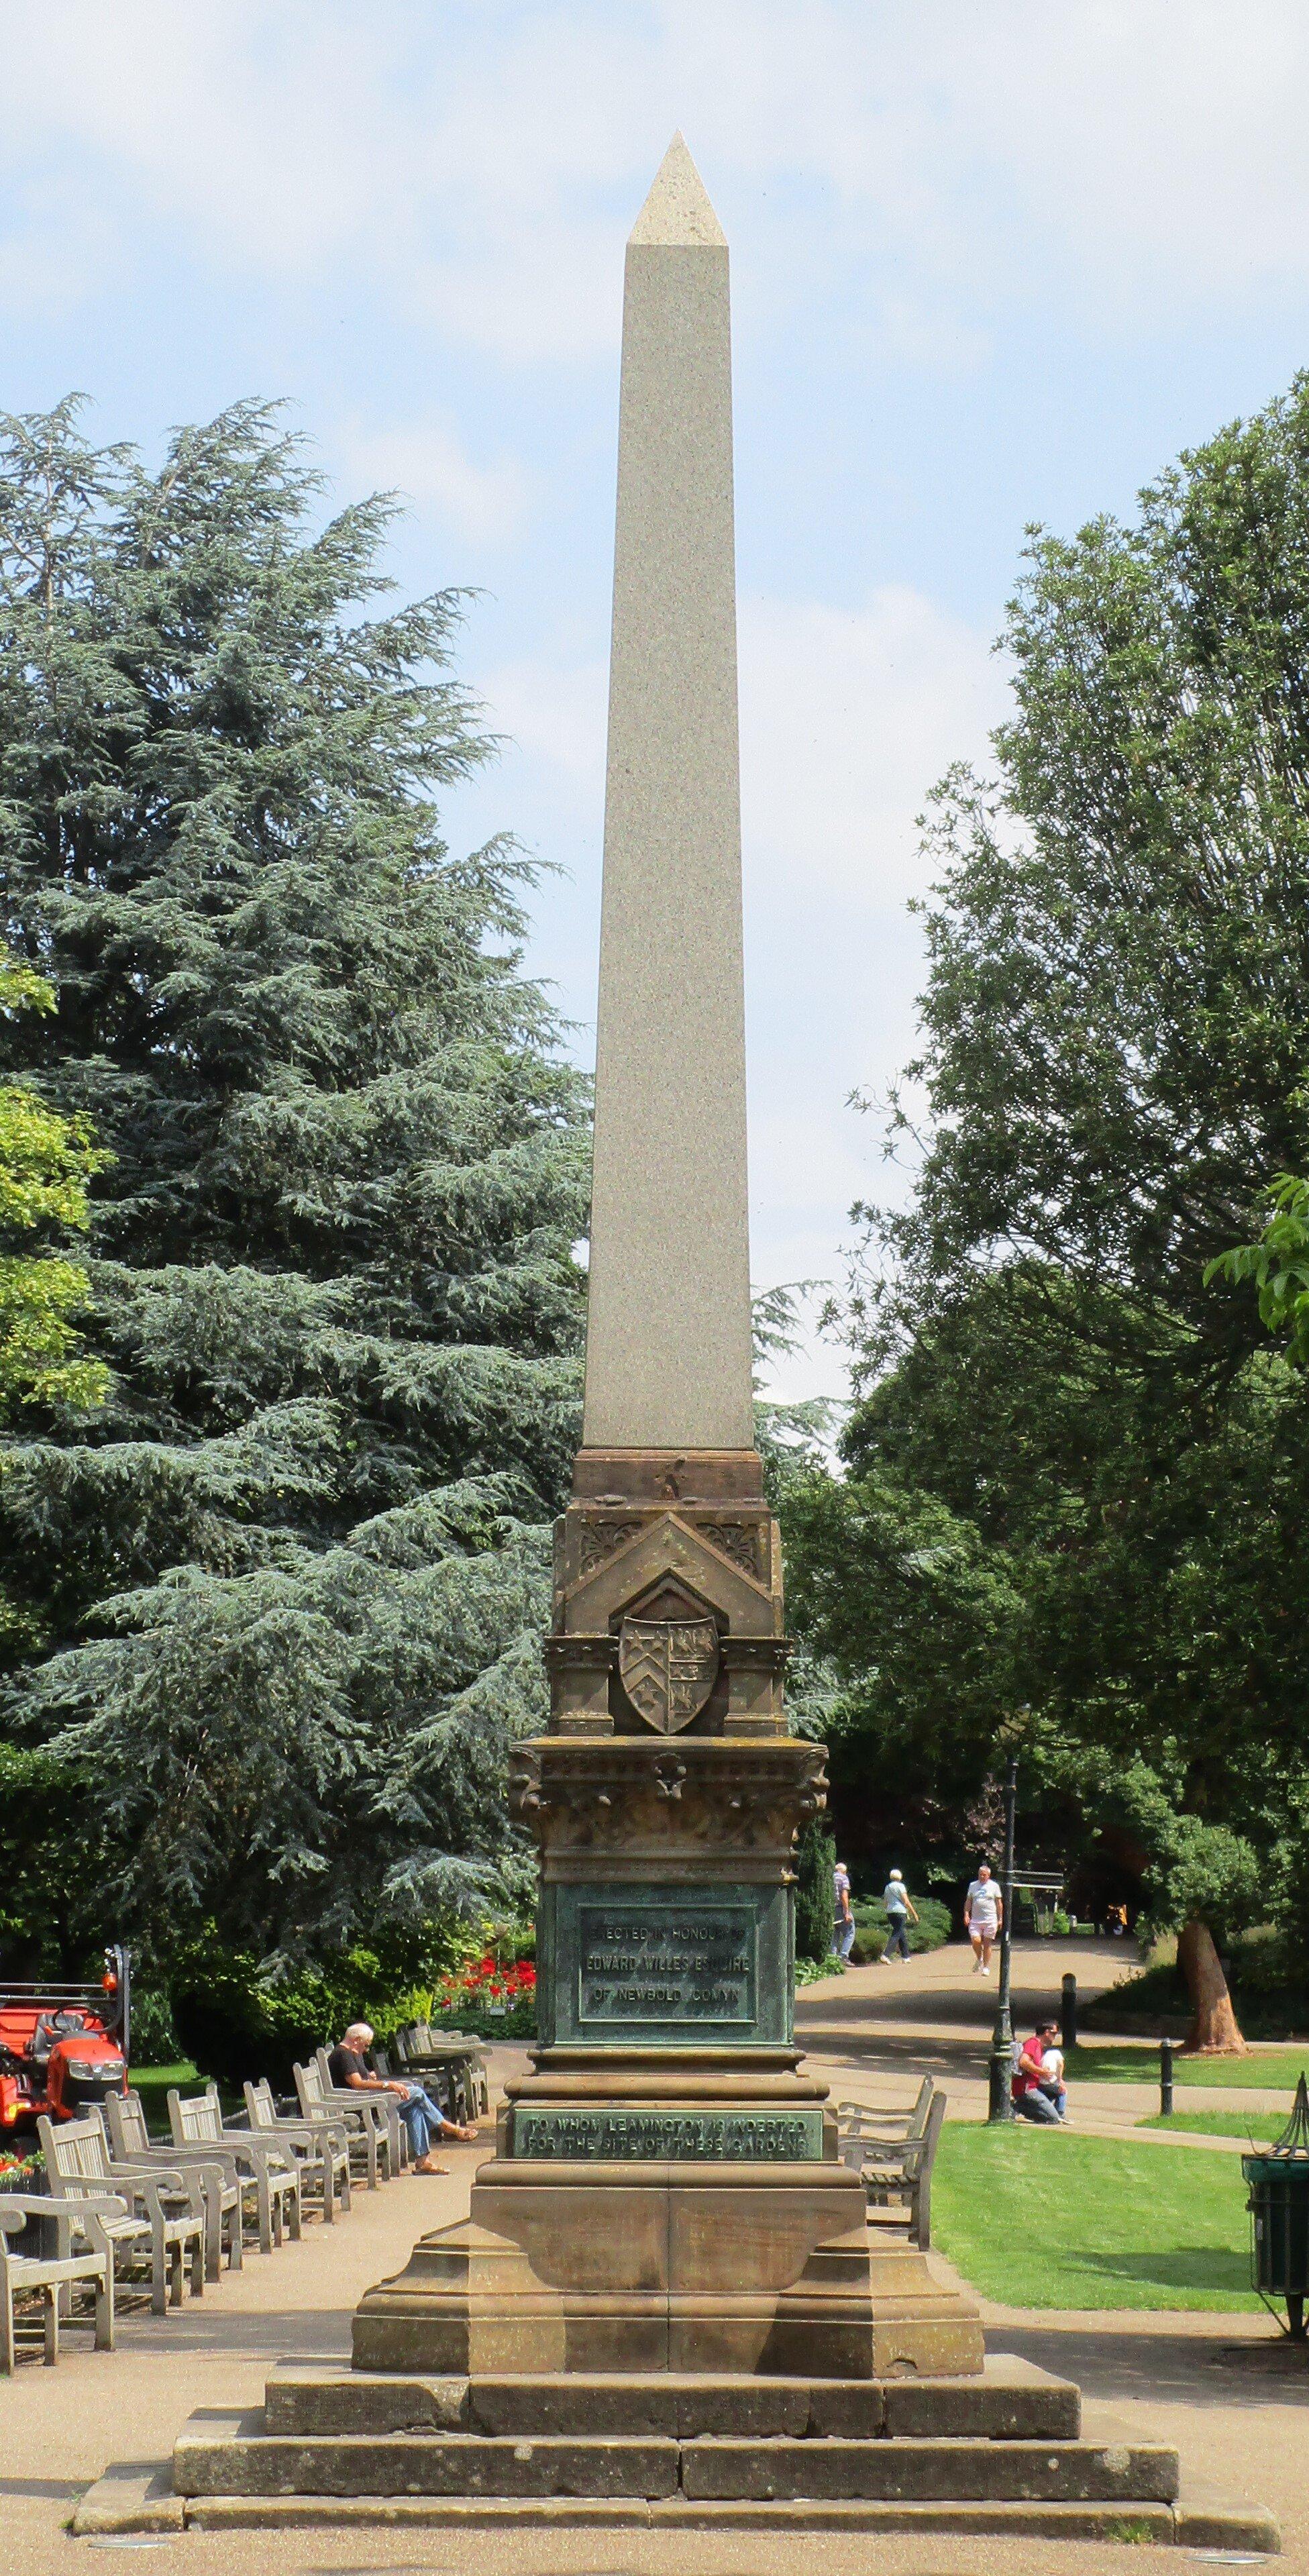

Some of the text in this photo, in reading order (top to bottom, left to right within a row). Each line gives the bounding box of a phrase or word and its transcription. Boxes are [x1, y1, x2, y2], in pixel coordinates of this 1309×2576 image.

[672, 1927, 726, 1940] HONOU
[587, 1955, 750, 1971] EDWARD WILLES ESUIRE
[594, 1988, 740, 2000] OF NEWBOLD COMYN
[529, 2118, 806, 2132] TO WHOM LEAMINGTON IS INDEBTED
[528, 2137, 806, 2152] FOR THE SITE OF THESE GARDENS
